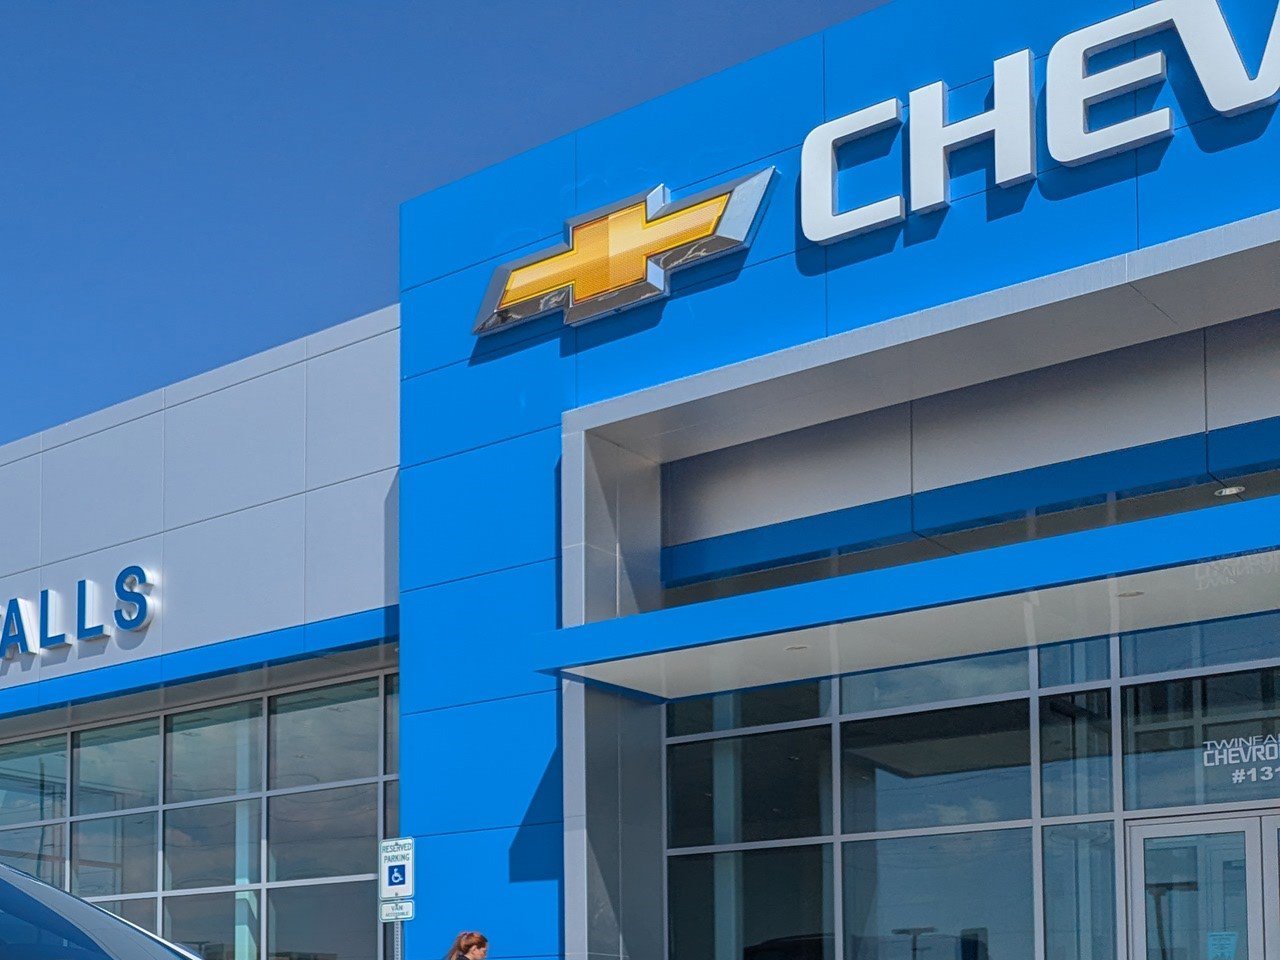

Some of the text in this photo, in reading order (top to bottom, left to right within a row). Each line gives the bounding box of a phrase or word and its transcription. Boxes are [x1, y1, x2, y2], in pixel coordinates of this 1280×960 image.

[1203, 734, 1280, 750] TWINFA
[1204, 744, 1280, 767] CHEVRO
[382, 843, 412, 853] RESERVED
[383, 854, 410, 863] PARKING
